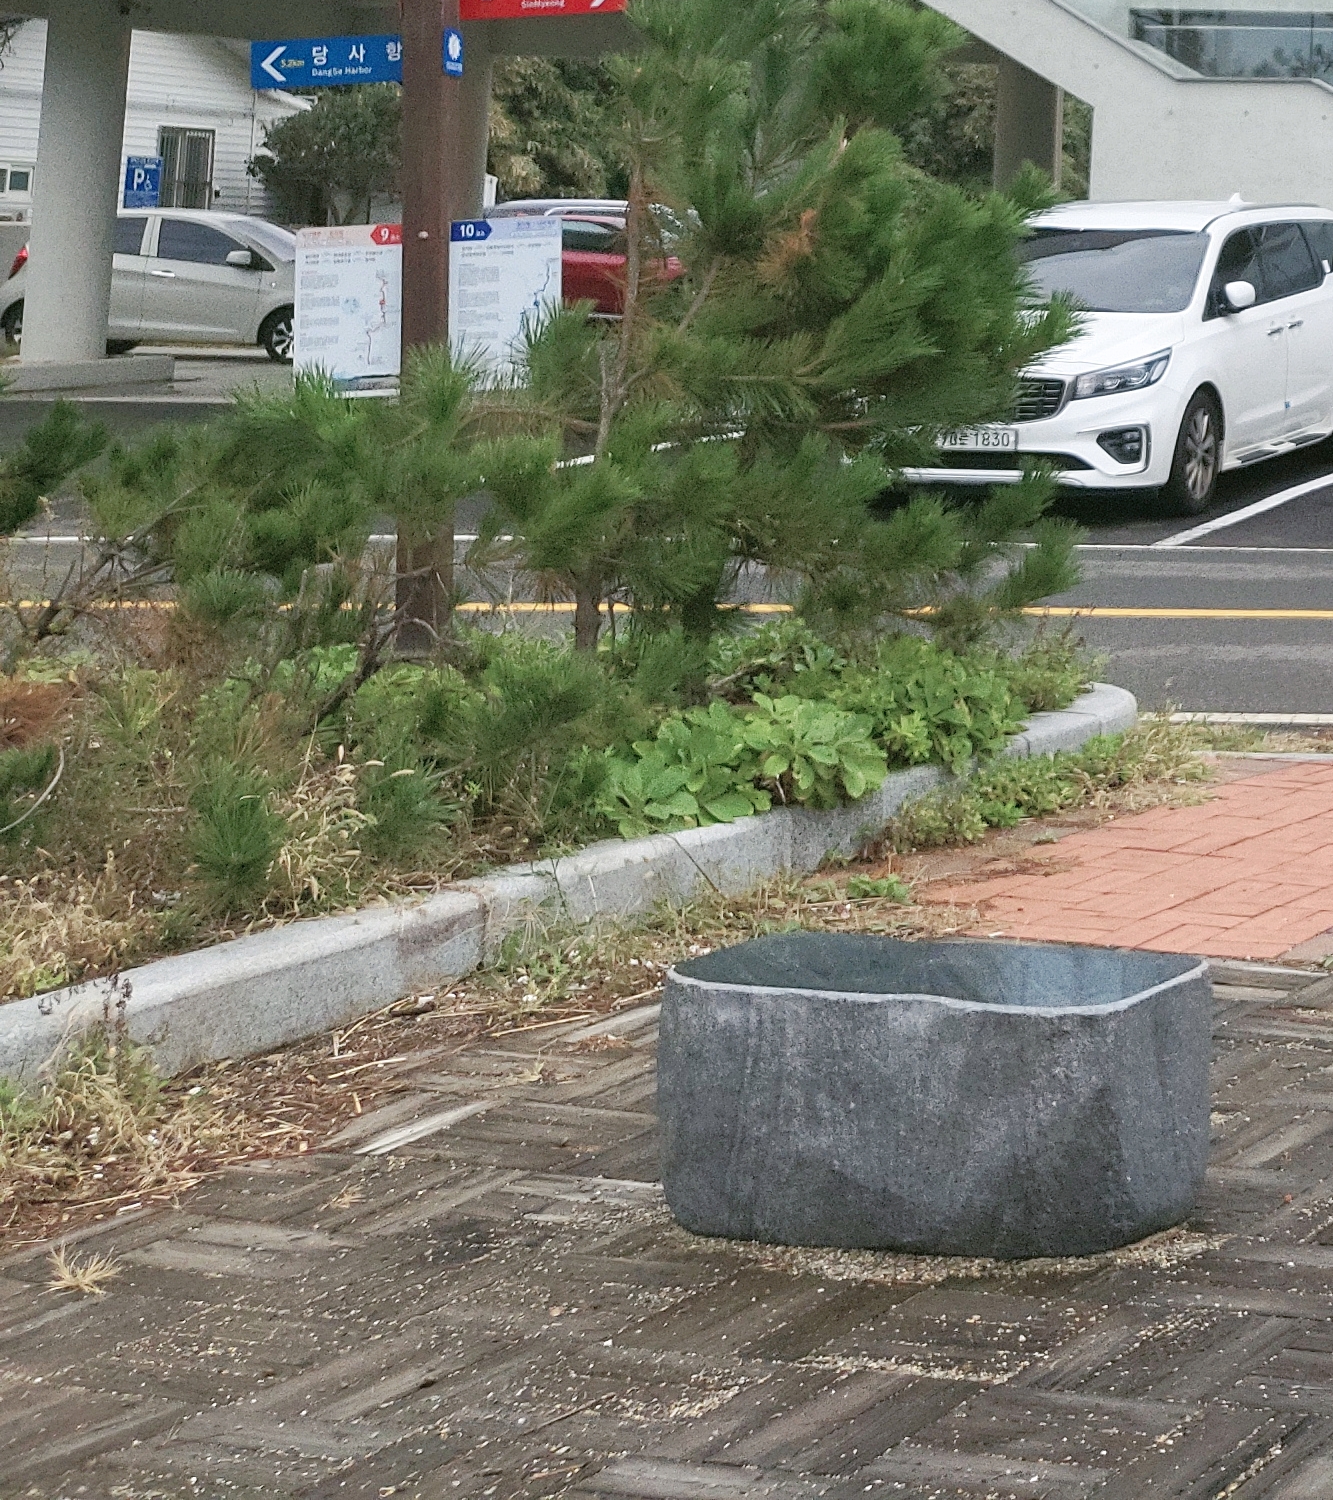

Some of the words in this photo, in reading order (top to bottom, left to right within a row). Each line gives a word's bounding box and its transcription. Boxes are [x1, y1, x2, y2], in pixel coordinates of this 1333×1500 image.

[381, 228, 390, 242] 9
[460, 224, 475, 238] 10
[972, 432, 1010, 447] 1830
